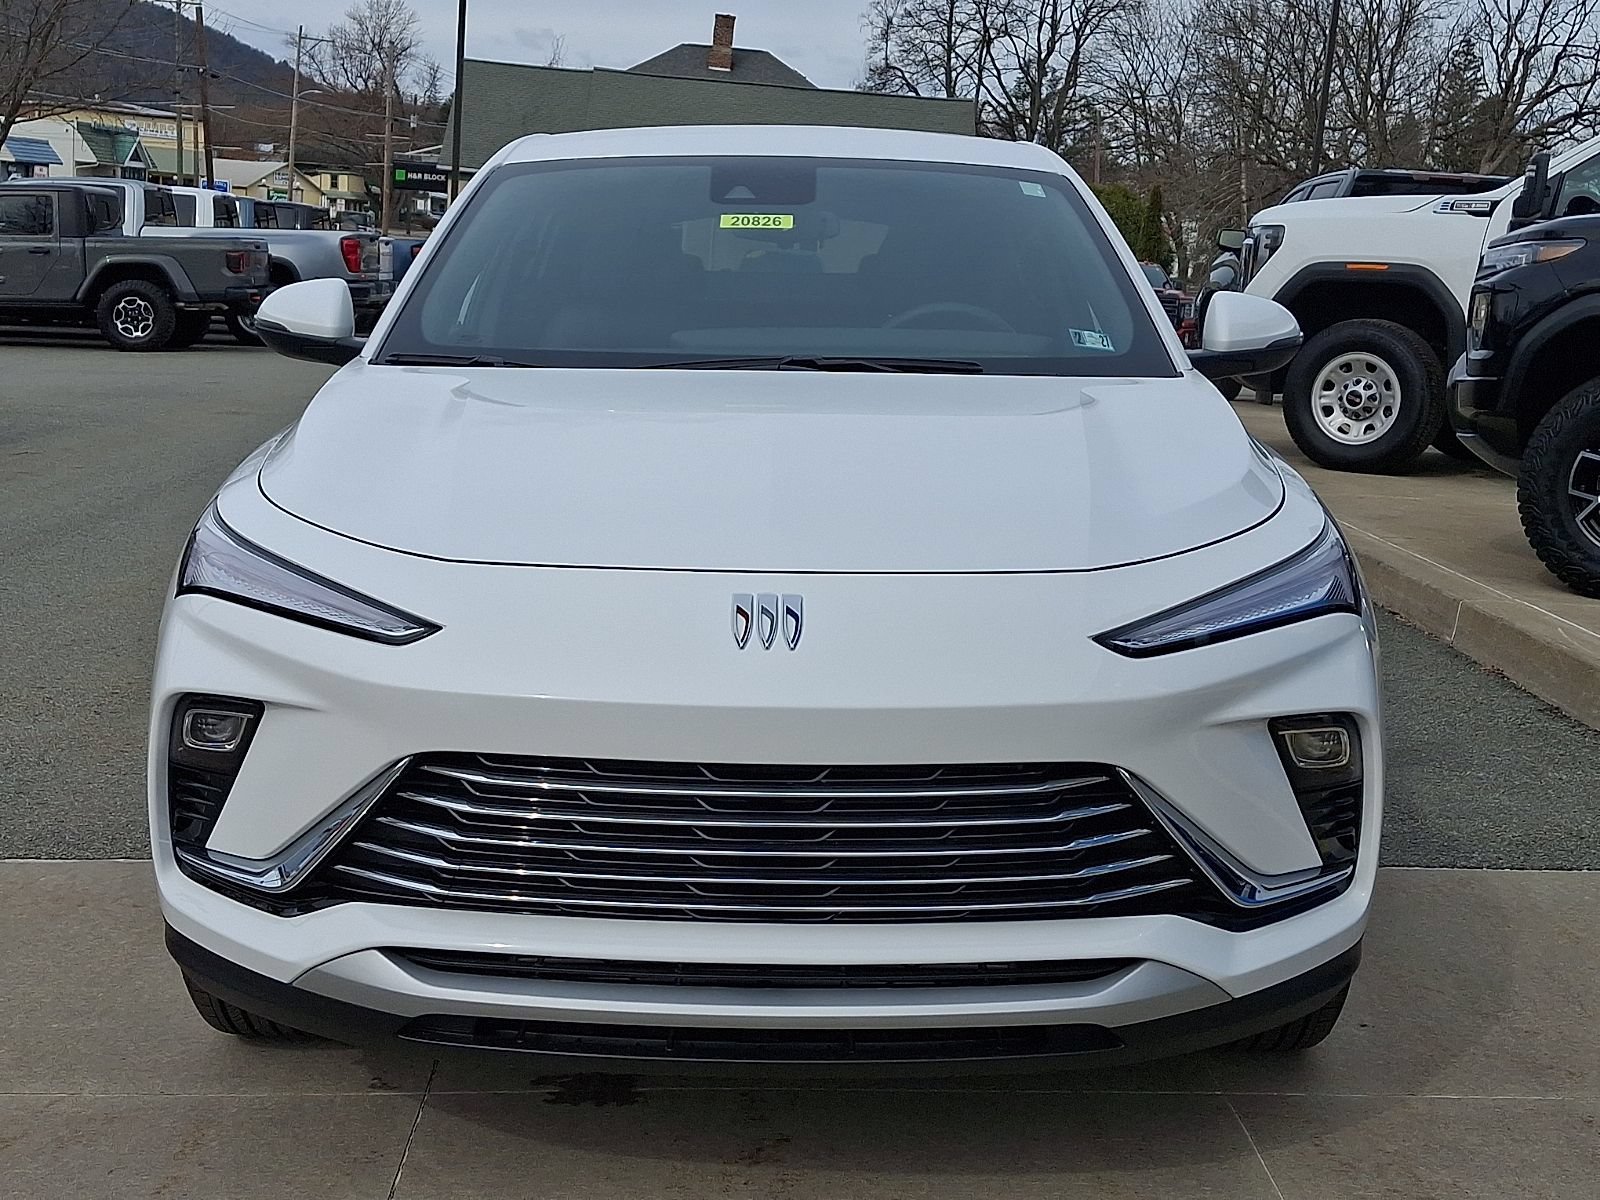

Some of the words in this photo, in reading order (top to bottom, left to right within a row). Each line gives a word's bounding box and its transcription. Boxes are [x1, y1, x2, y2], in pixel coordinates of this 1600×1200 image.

[407, 172, 422, 180] H&R
[423, 173, 447, 182] BLOCK
[730, 216, 782, 227] 20826
